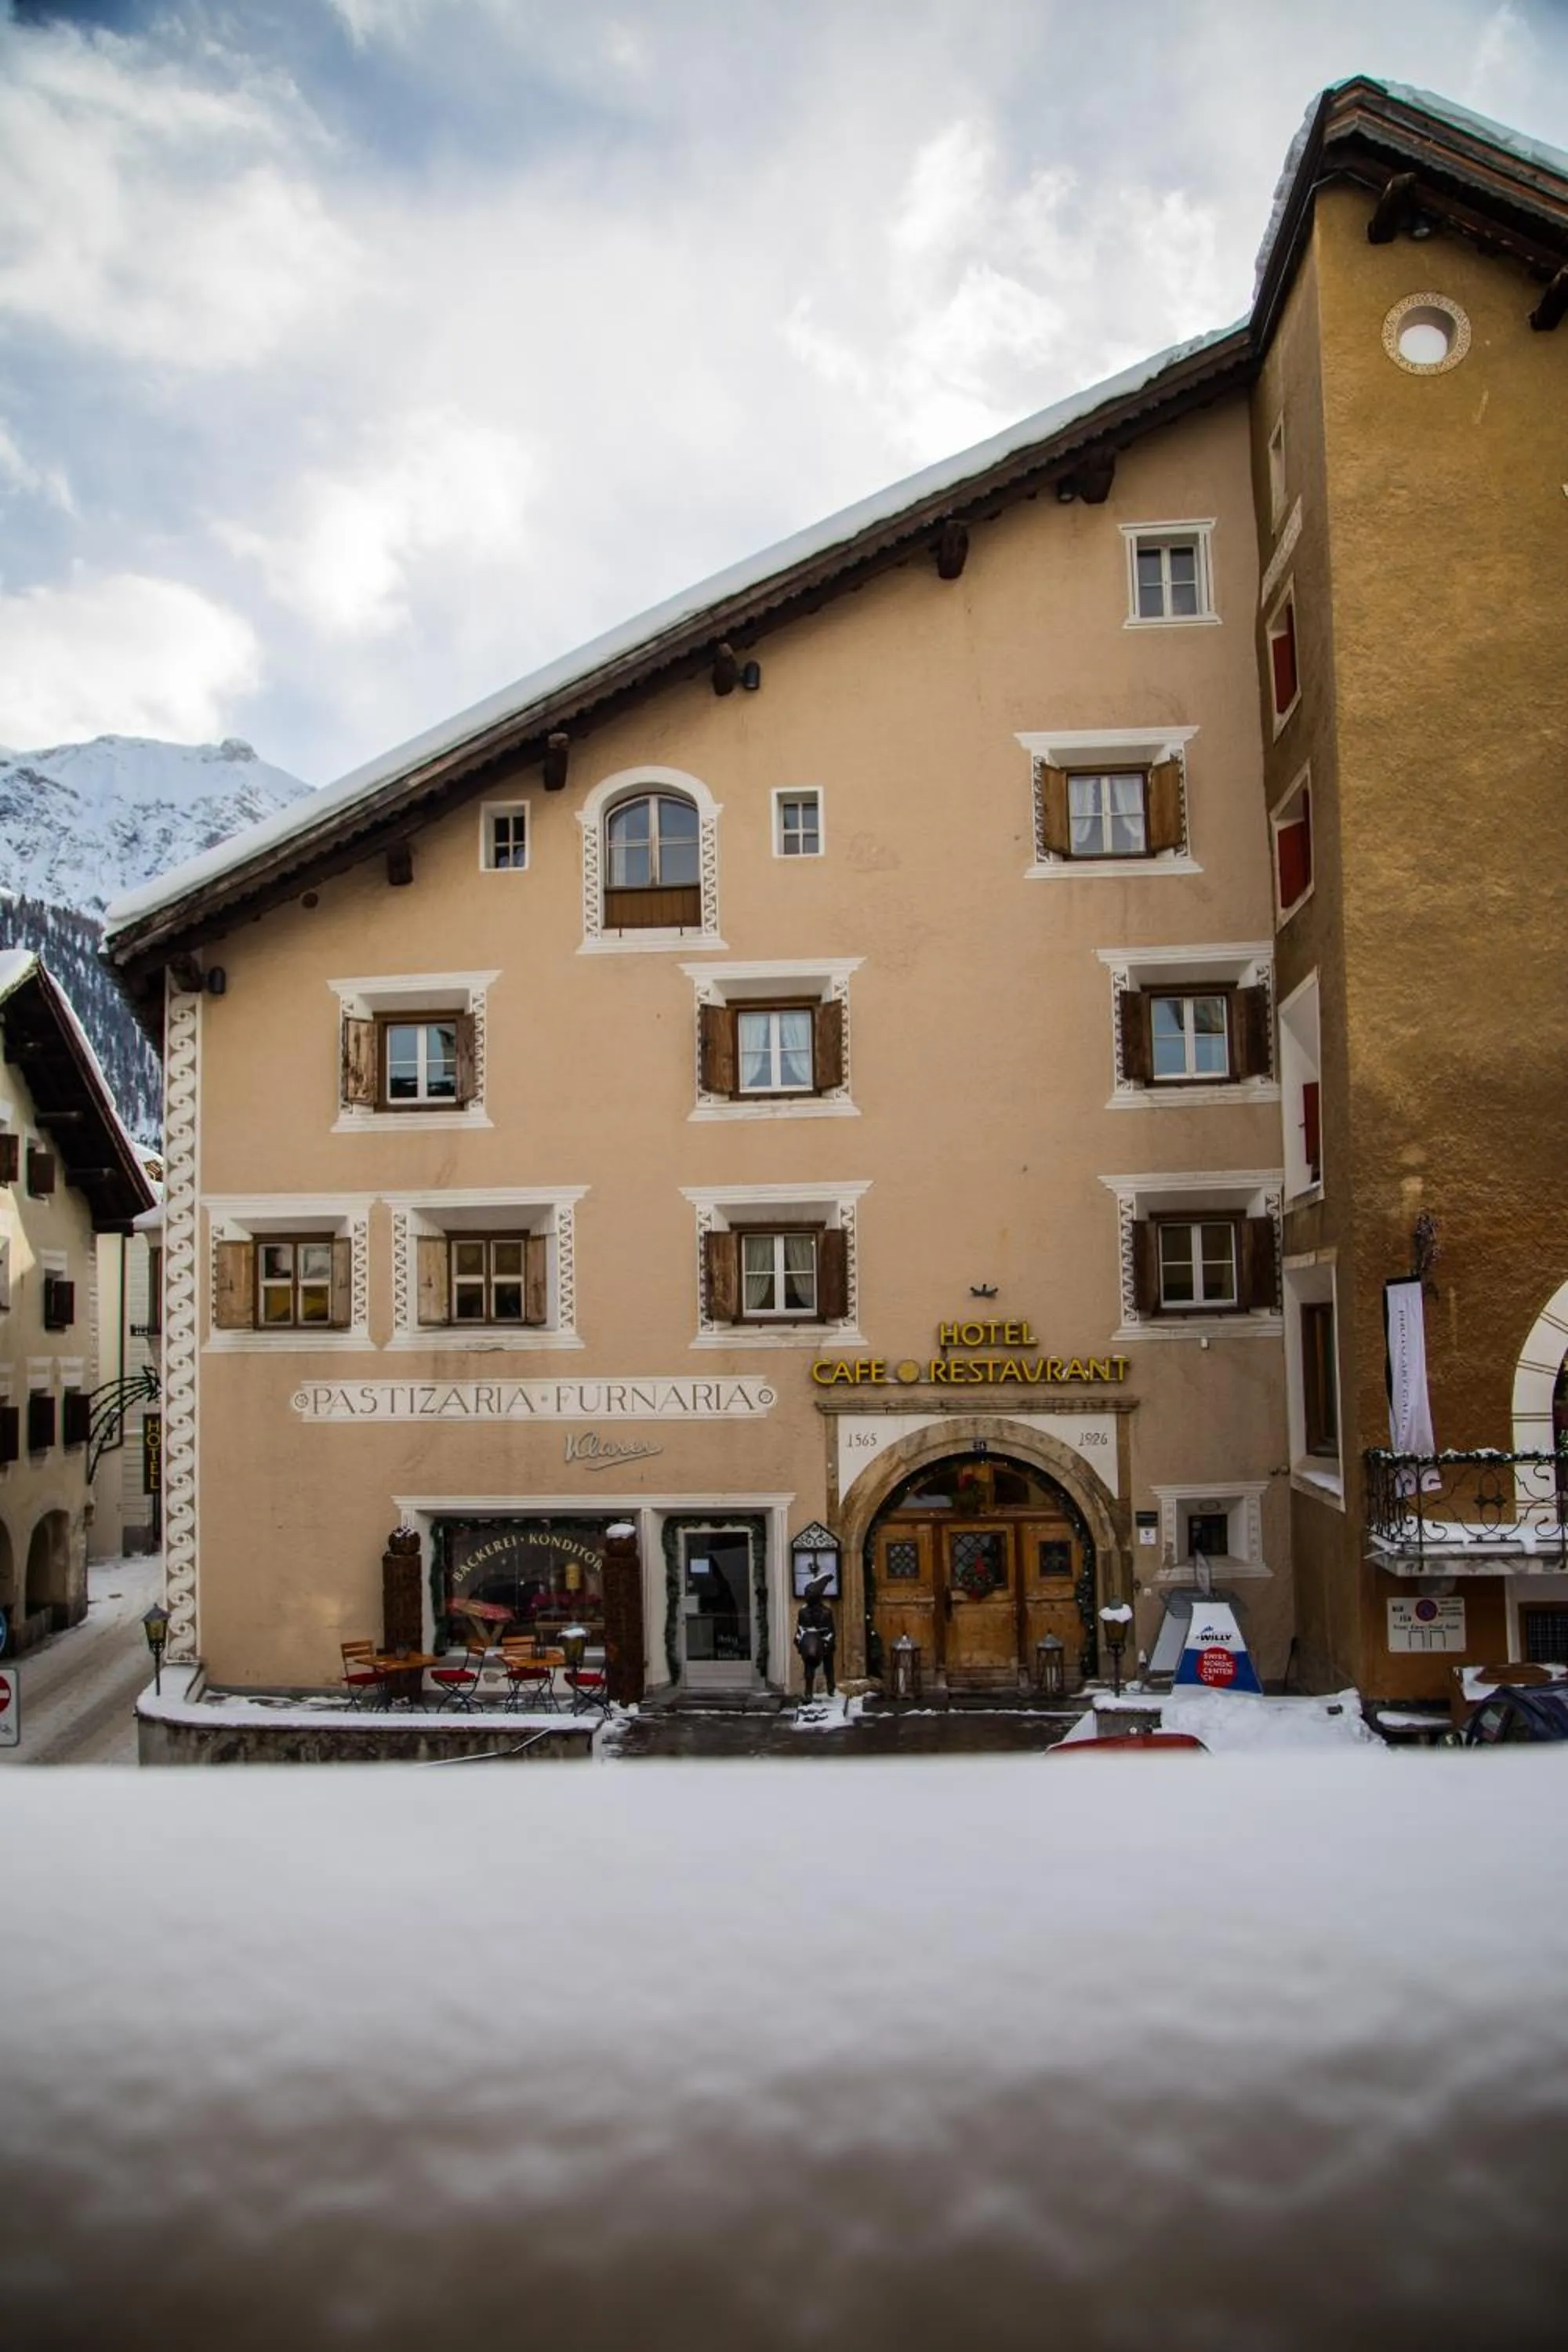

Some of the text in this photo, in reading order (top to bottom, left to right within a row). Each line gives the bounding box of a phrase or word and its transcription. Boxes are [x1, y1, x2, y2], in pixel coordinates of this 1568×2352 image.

[940, 1321, 1039, 1346] HOTEL
[812, 1359, 886, 1384] CAFE
[313, 1384, 755, 1415] PASTIZARIA FURNARIA
[847, 1432, 877, 1447] 1565
[147, 1420, 160, 1489] HOTEL
